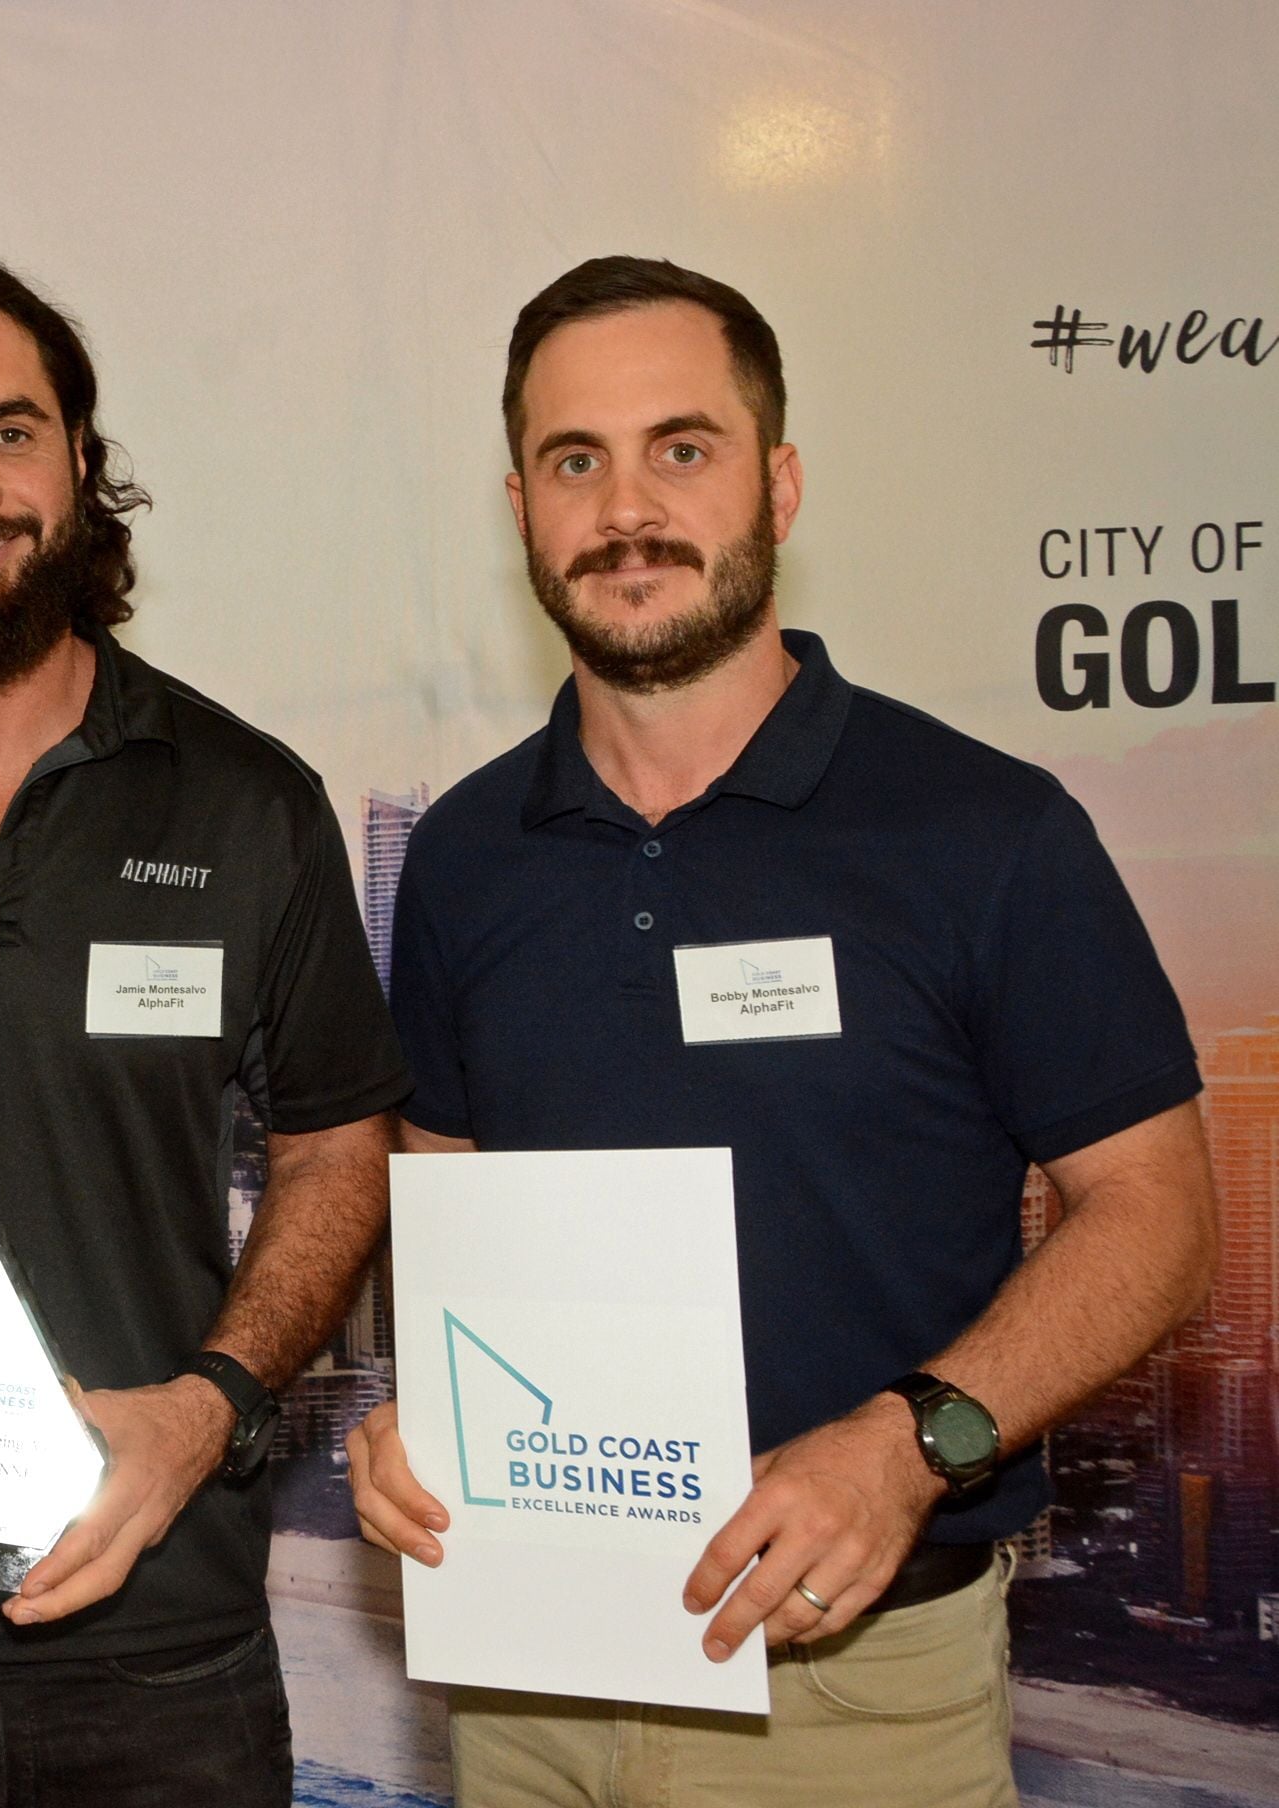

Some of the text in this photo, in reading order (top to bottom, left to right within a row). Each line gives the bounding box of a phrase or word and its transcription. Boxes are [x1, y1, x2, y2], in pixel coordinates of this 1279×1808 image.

[1031, 304, 1279, 374] #wea
[1039, 521, 1263, 579] CITY OF
[1035, 599, 1276, 712] GOL
[120, 858, 212, 889] ALPHAFIT
[116, 984, 207, 995] Jamie Montesalvo
[138, 997, 184, 1010] AlphaFit
[710, 983, 820, 1003] Bobby Montesalvo
[740, 1000, 795, 1016] AlphaFit
[506, 1430, 701, 1464] GOLD COAST
[509, 1461, 703, 1501] BUSINESS
[512, 1497, 702, 1524] EXCELLENCE AWARDS
